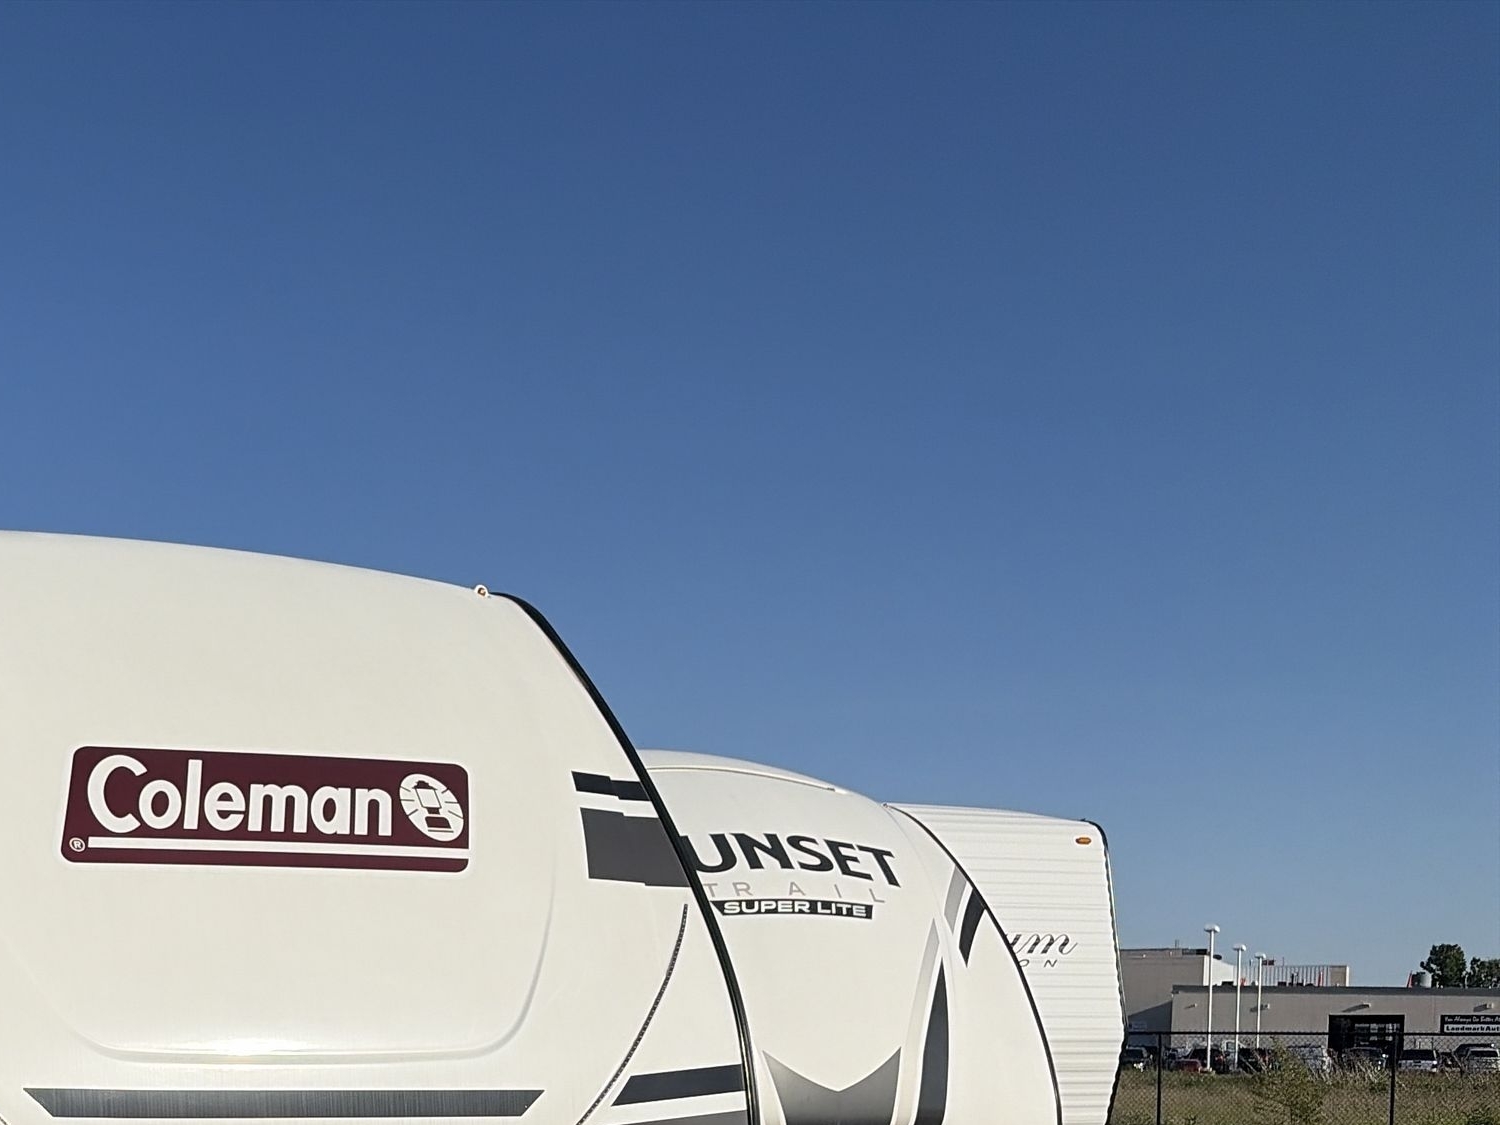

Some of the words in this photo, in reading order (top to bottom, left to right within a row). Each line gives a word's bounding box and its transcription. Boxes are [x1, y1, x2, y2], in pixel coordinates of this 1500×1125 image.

[87, 754, 393, 837] Coleman
[680, 832, 901, 888] UNSET
[703, 881, 886, 903] TRAIL
[723, 900, 811, 914] SUPER
[817, 902, 867, 917] LITE
